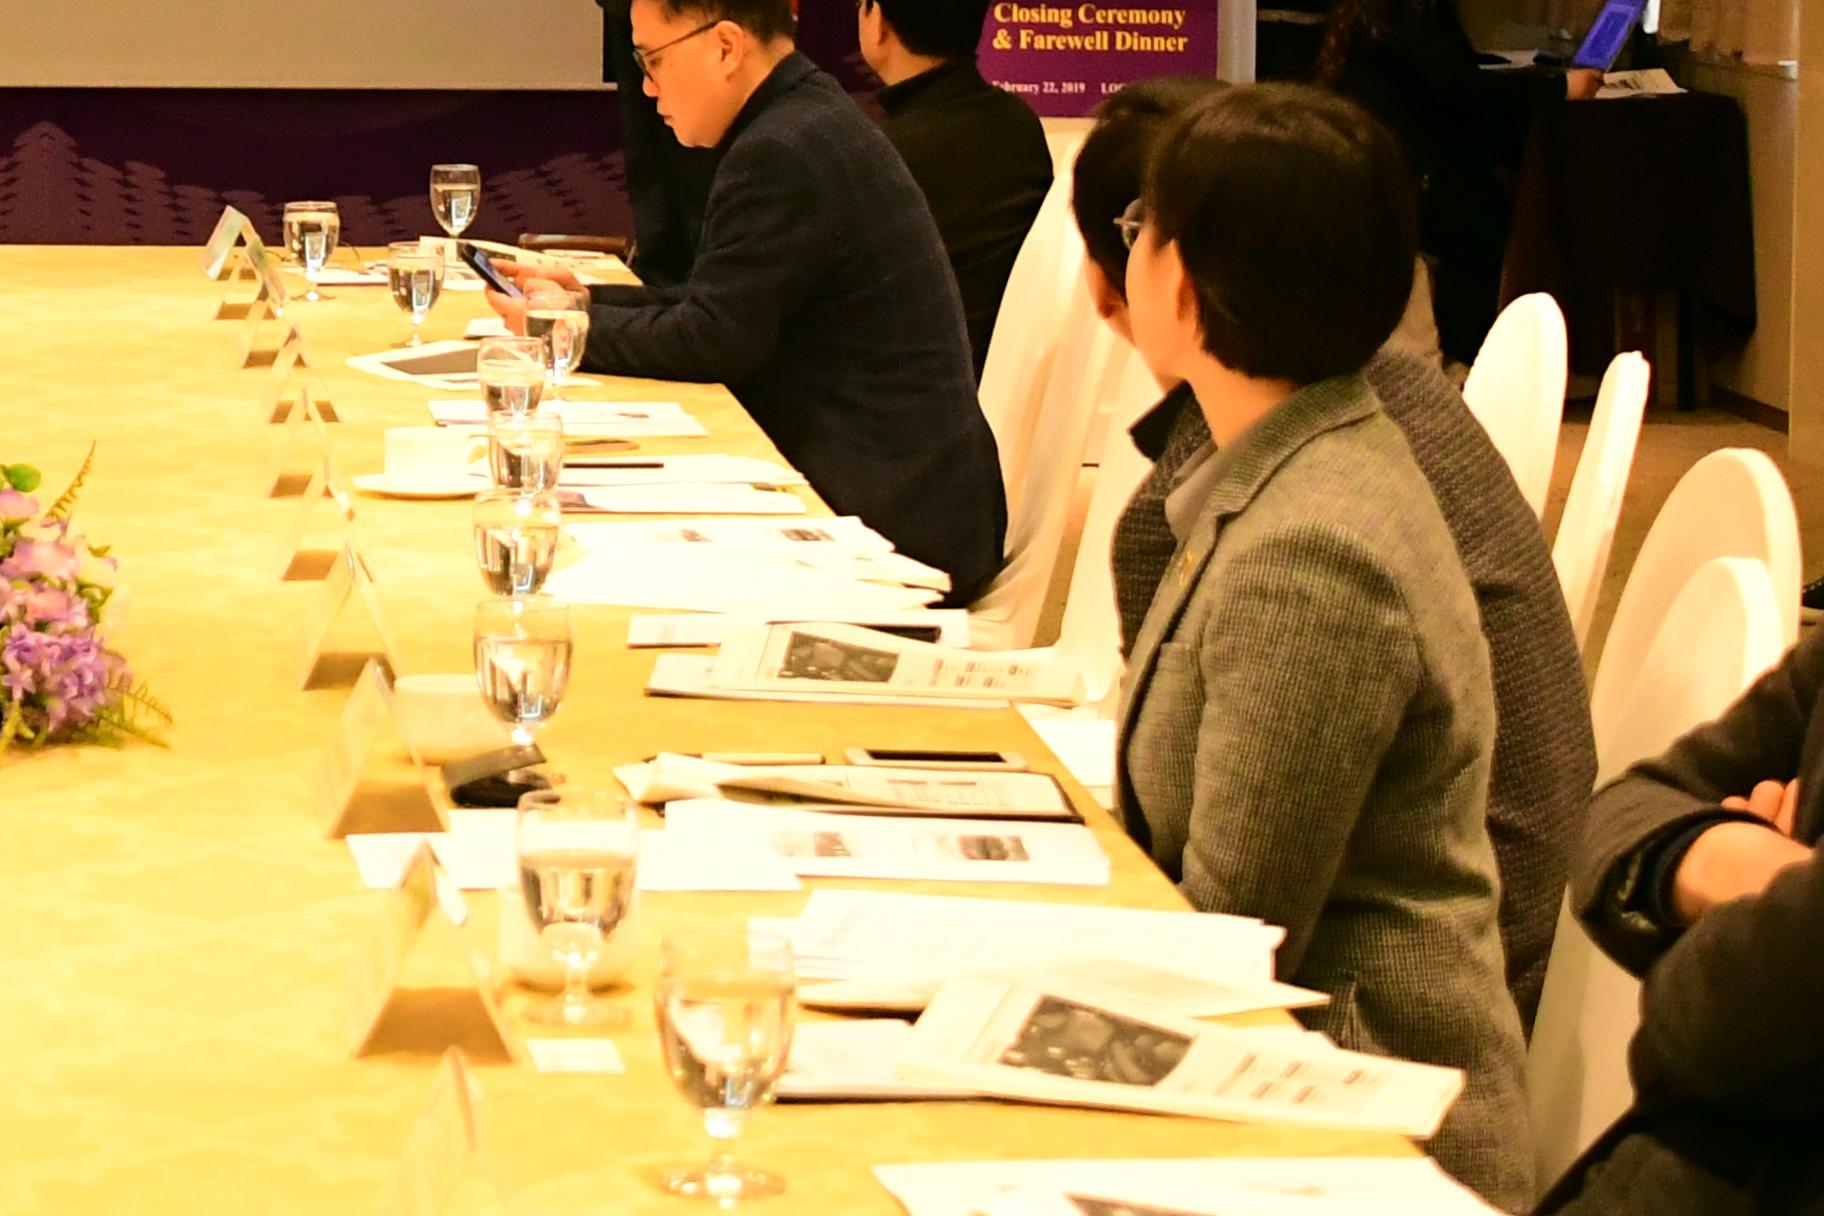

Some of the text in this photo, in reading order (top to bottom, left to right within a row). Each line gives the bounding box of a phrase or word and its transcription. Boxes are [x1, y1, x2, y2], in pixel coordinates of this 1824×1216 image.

[994, 3, 1186, 29] Closing Ceremony
[992, 29, 1188, 52] & Farewell Dinner
